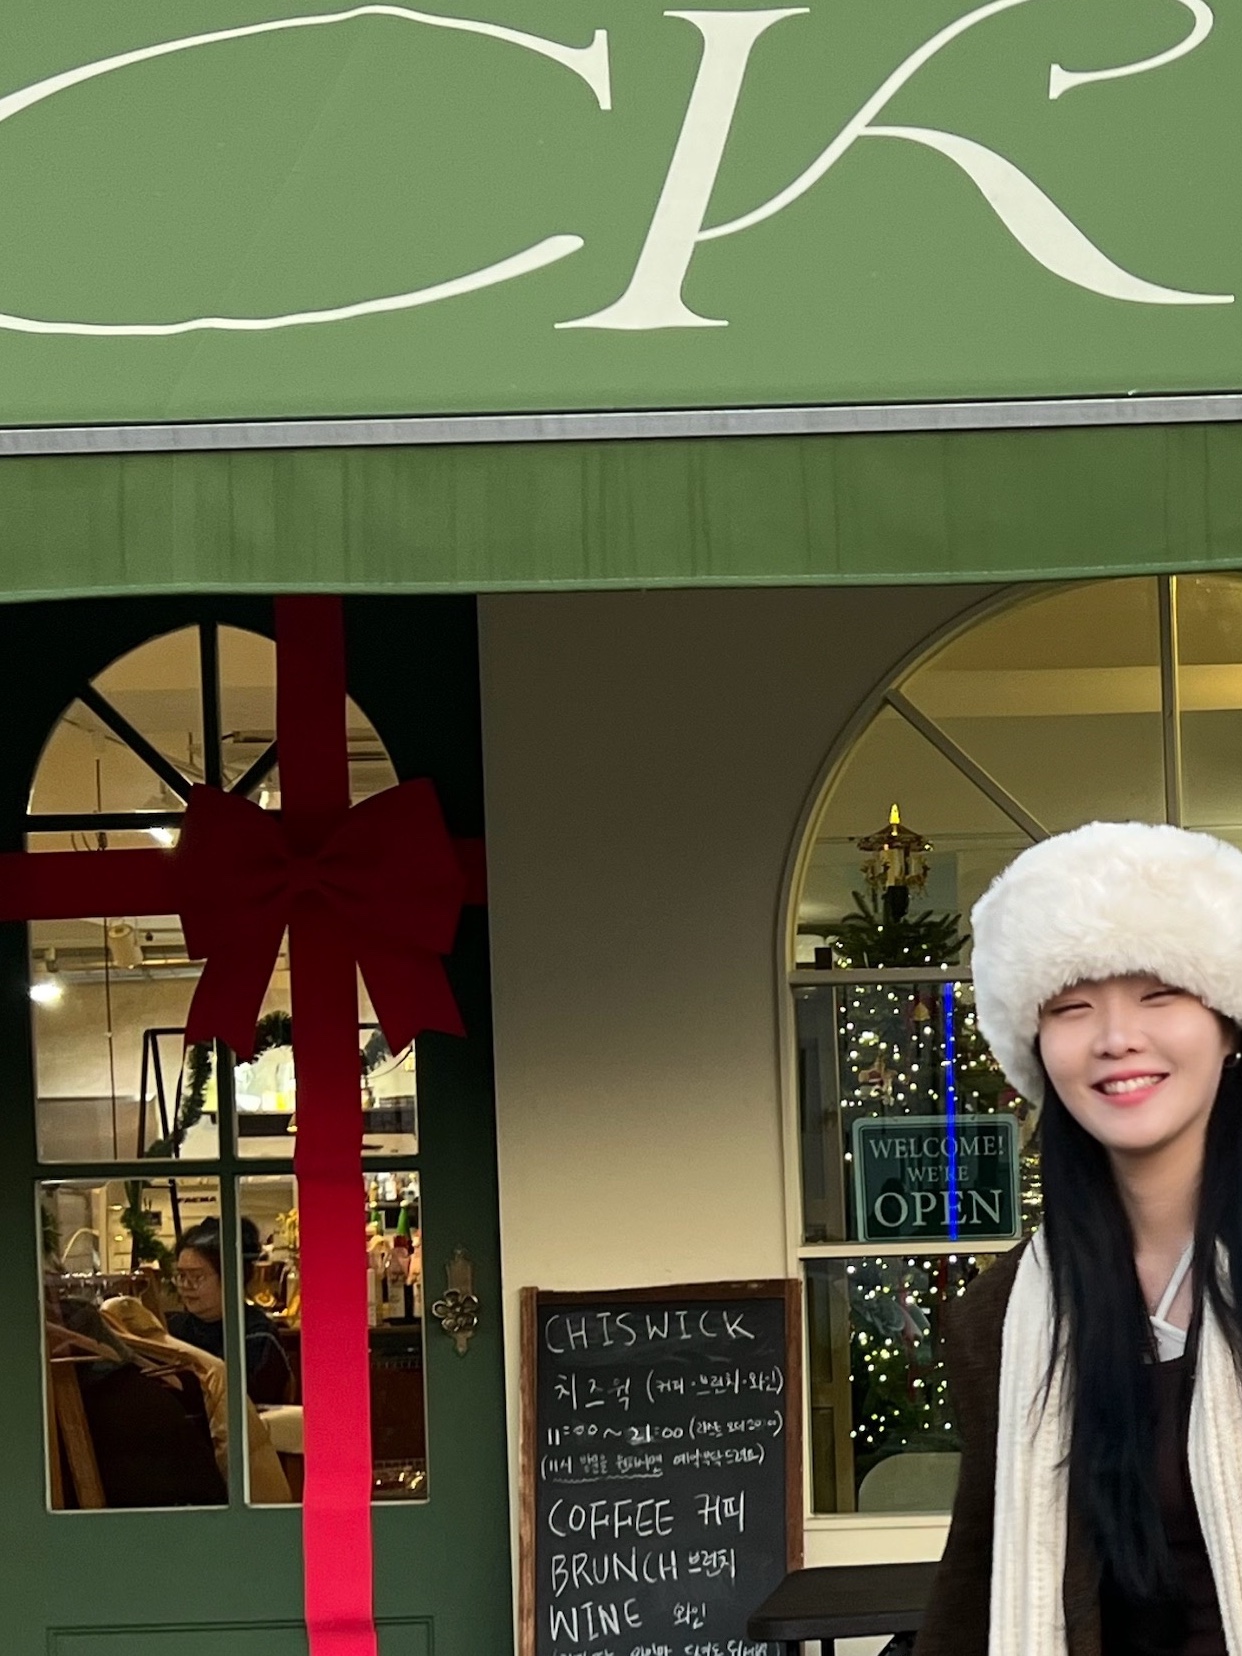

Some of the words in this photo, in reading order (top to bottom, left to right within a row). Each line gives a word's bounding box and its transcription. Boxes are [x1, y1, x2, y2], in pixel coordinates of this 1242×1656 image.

[869, 1136, 1004, 1159] WELCOME!
[874, 1189, 1003, 1228] OPEN
[545, 1311, 754, 1353] CHISWICK
[549, 1498, 675, 1540] COFFEE
[694, 1490, 744, 1533] 커피
[551, 1547, 678, 1597] BRUNCH
[550, 1599, 643, 1642] WINE
[673, 1602, 706, 1630] 와인
